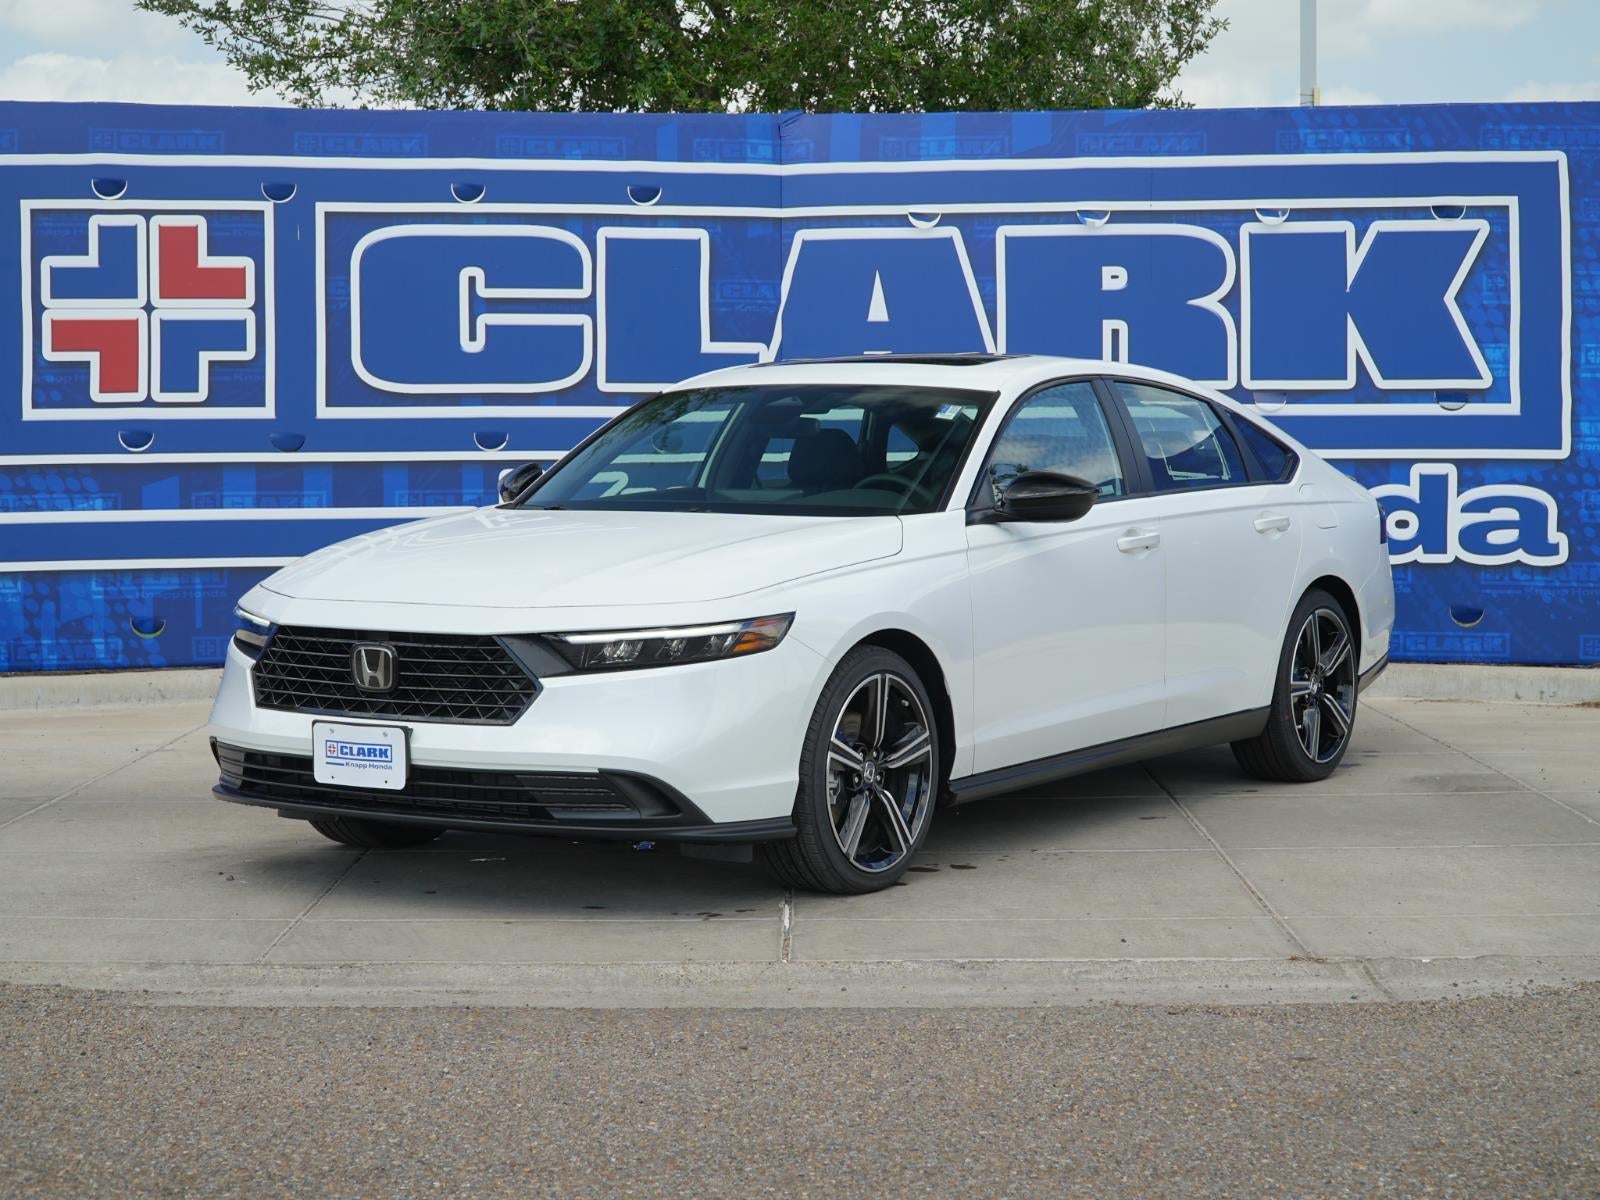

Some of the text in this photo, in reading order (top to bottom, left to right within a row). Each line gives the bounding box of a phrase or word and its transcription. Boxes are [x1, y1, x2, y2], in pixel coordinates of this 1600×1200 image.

[350, 218, 1493, 394] CLARK
[339, 745, 389, 759] CLARK
[345, 761, 393, 771] Knapp Honda
